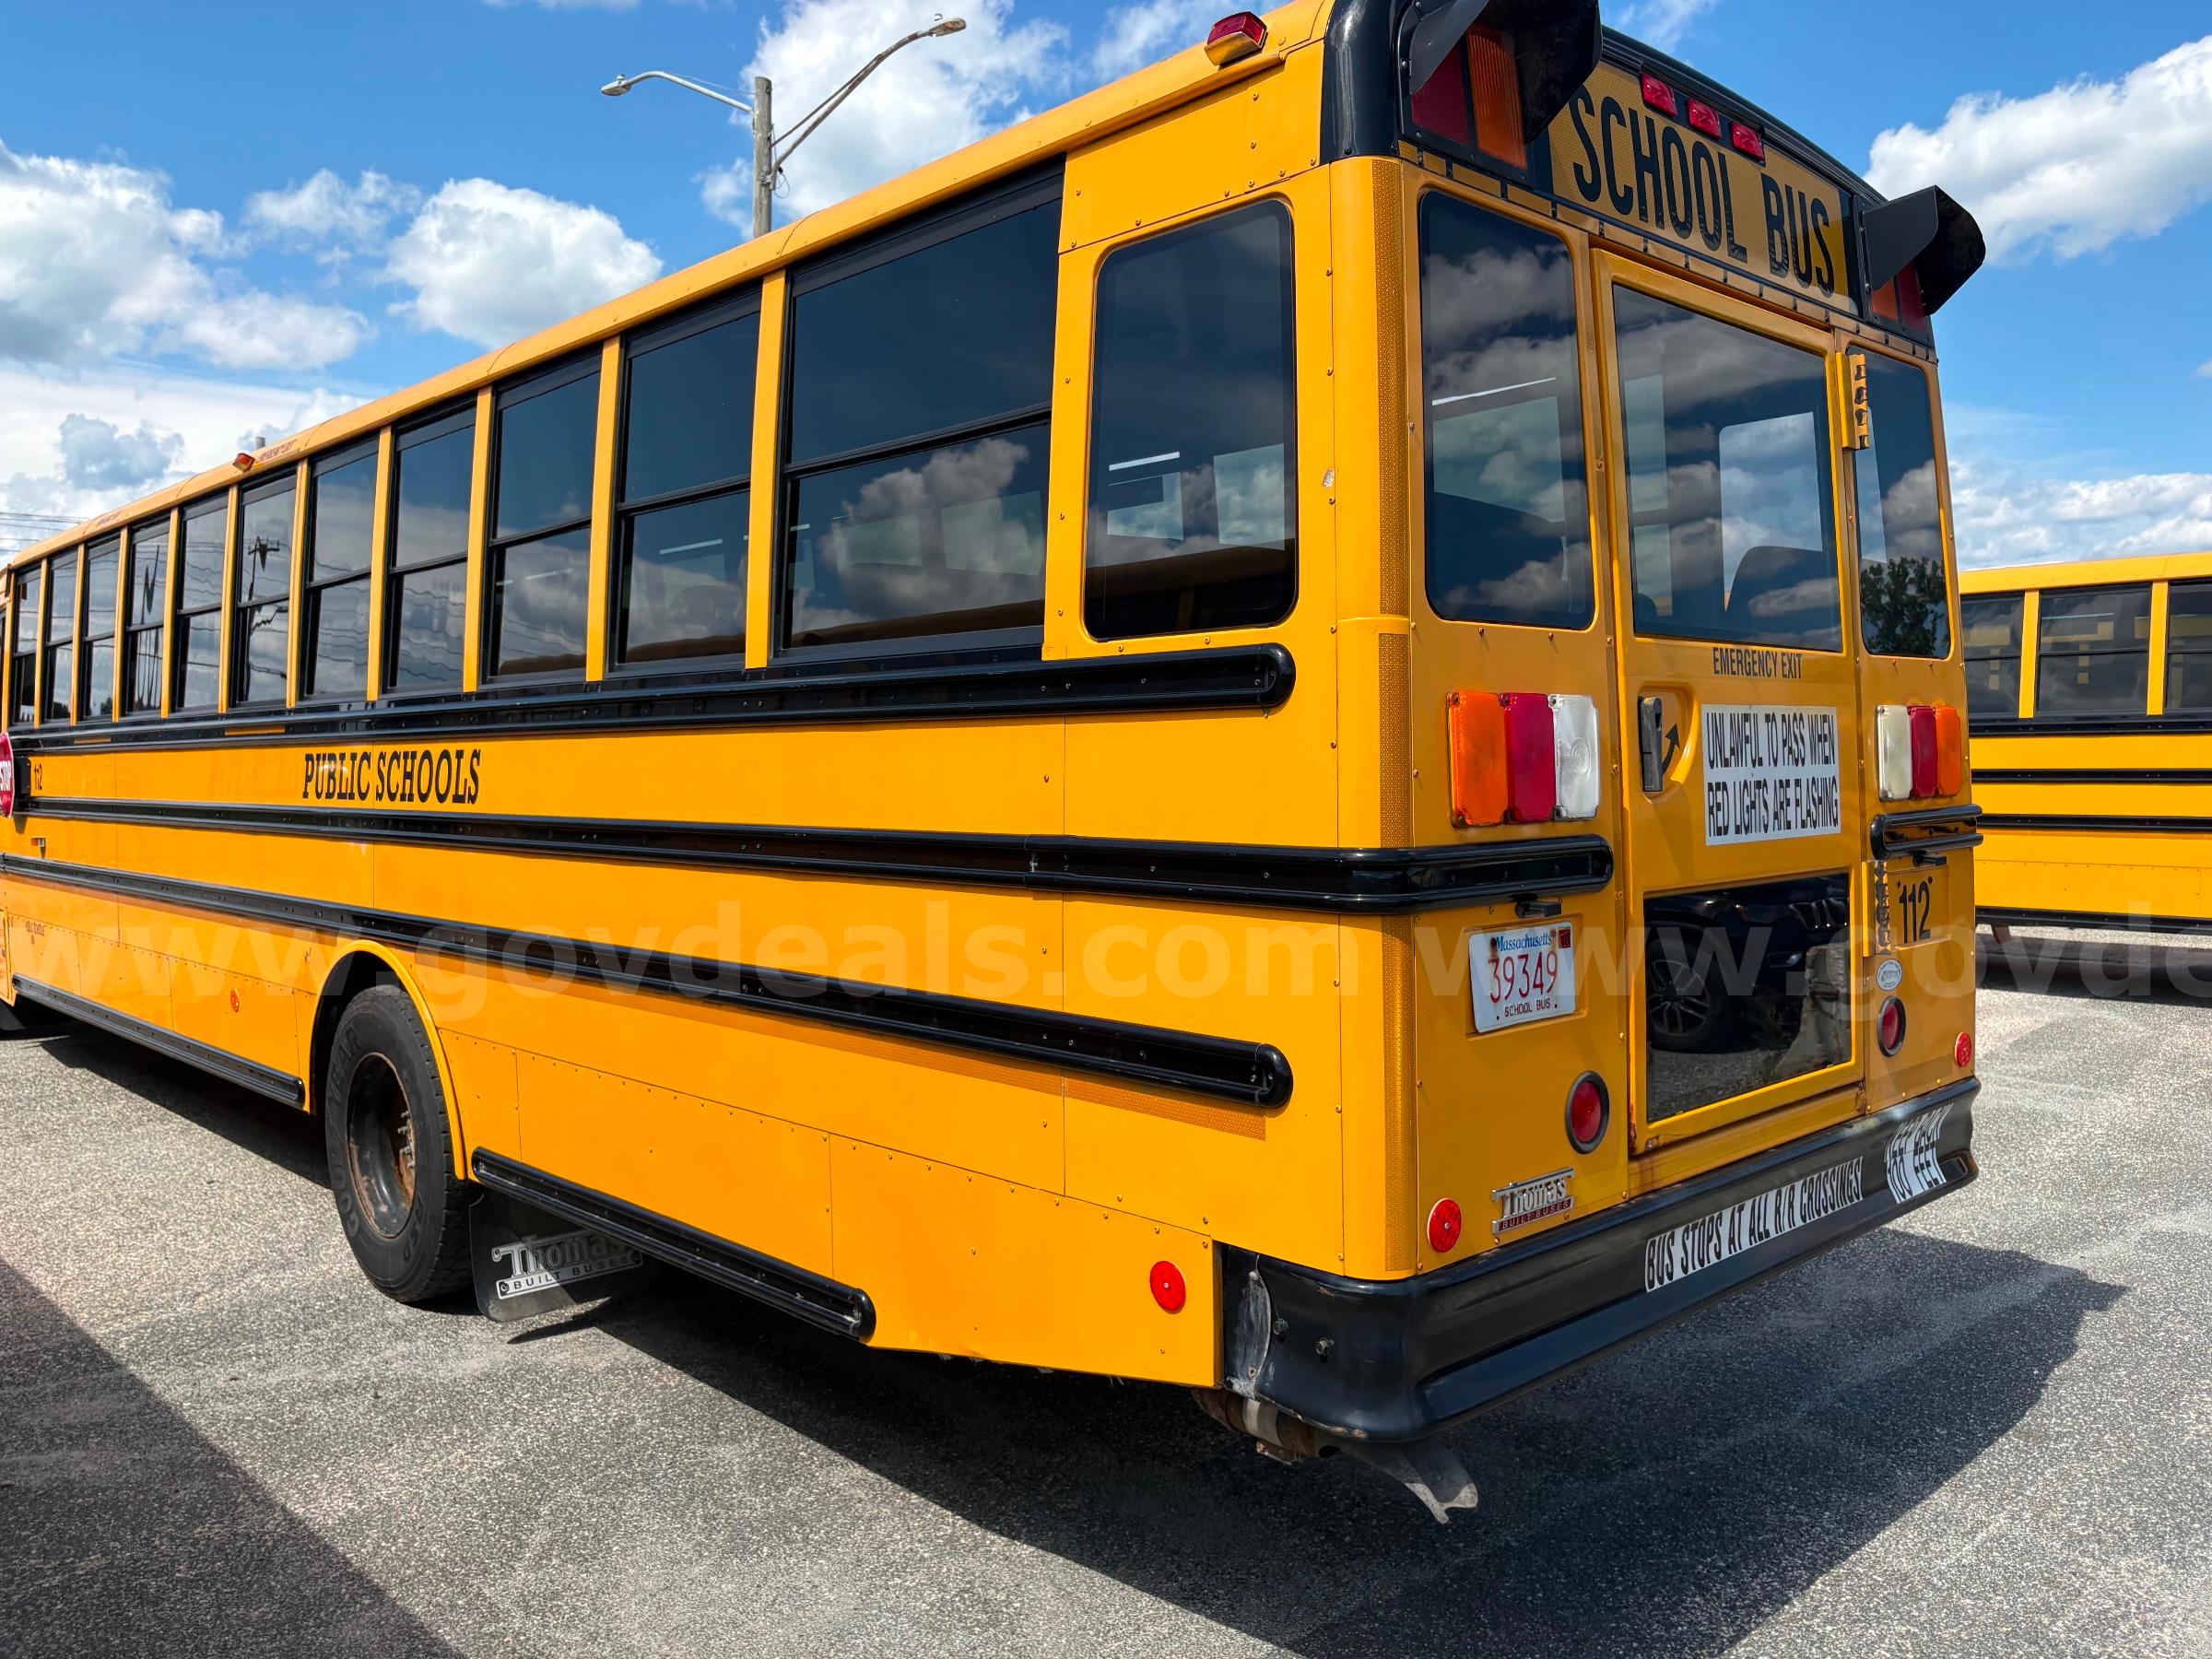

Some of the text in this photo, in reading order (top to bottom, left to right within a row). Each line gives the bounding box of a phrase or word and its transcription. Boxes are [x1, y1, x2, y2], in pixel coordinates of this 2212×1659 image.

[1569, 85, 1835, 298] SCHOOL BUS
[1712, 647, 1803, 679] EMERGENCY EXIT
[1706, 712, 1835, 771] UNLAWFUL TO PASS WHEN
[302, 748, 481, 805] PUBLIC SCHOOLS
[1707, 775, 1839, 838] RED LIGHTS ARE FLASHING
[1899, 880, 1932, 944] 112
[1496, 933, 1552, 952] Massachusetts
[1488, 950, 1559, 1004] 39349
[1504, 998, 1551, 1018] SCHOOL BUS
[1494, 1168, 1574, 1218] Thomas
[1887, 1141, 1945, 1203] 100 FEET
[1501, 1201, 1569, 1230] BUILT BUSES
[1646, 1156, 1863, 1290] BUS STOPS AT ALL R/R CROSSINGS
[513, 1255, 629, 1290] BUILT BUSES
